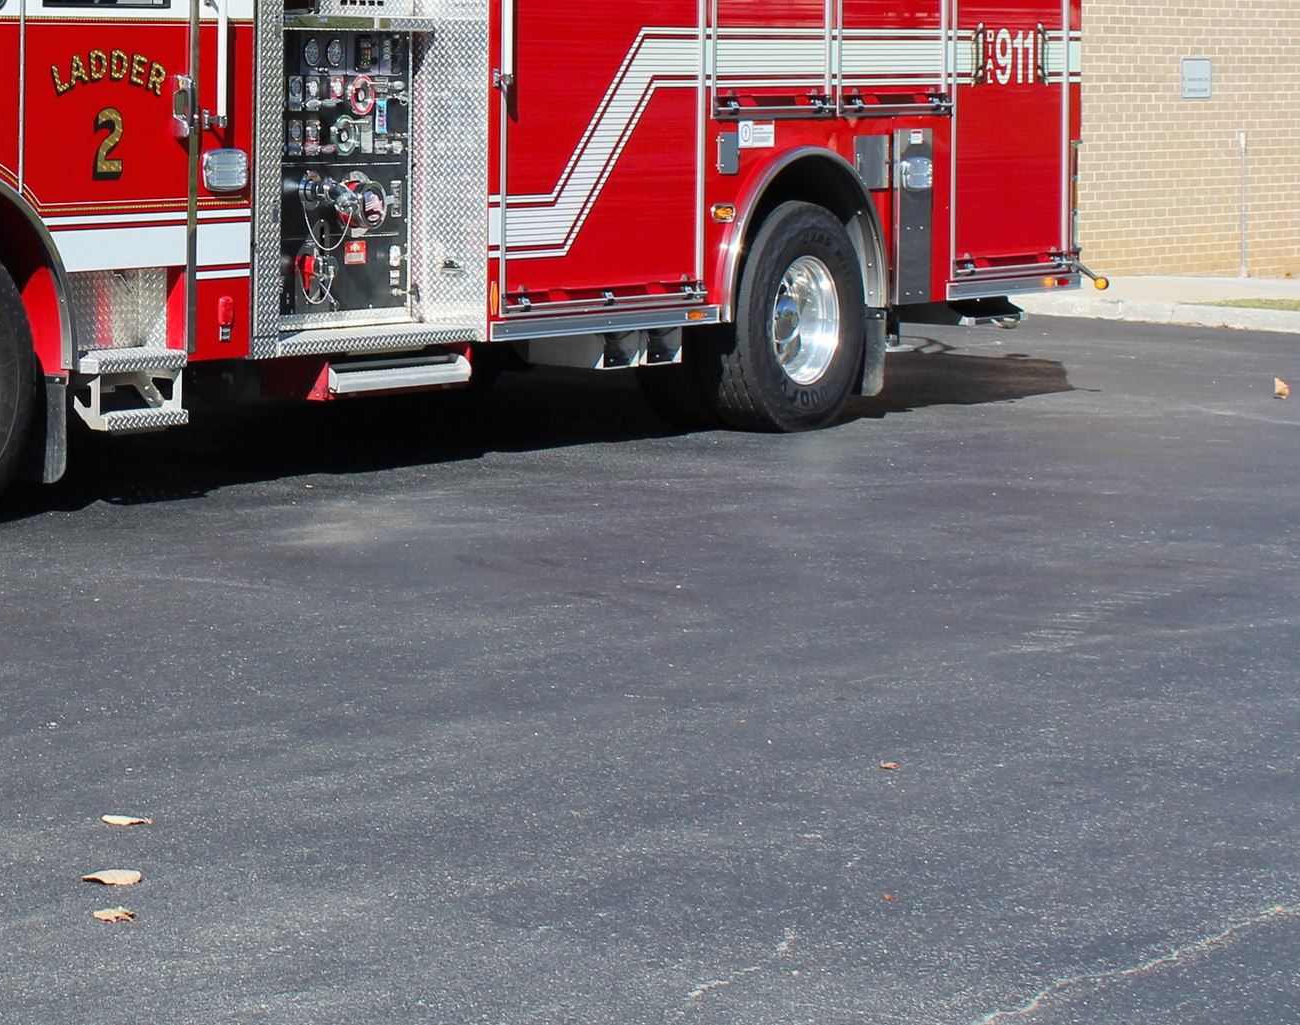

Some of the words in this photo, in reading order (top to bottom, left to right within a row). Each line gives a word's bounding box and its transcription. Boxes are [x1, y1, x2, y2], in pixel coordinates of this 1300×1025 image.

[51, 49, 166, 96] LADDER
[986, 29, 995, 84] DIAL
[995, 27, 1035, 85] 911
[93, 107, 123, 181] 2
